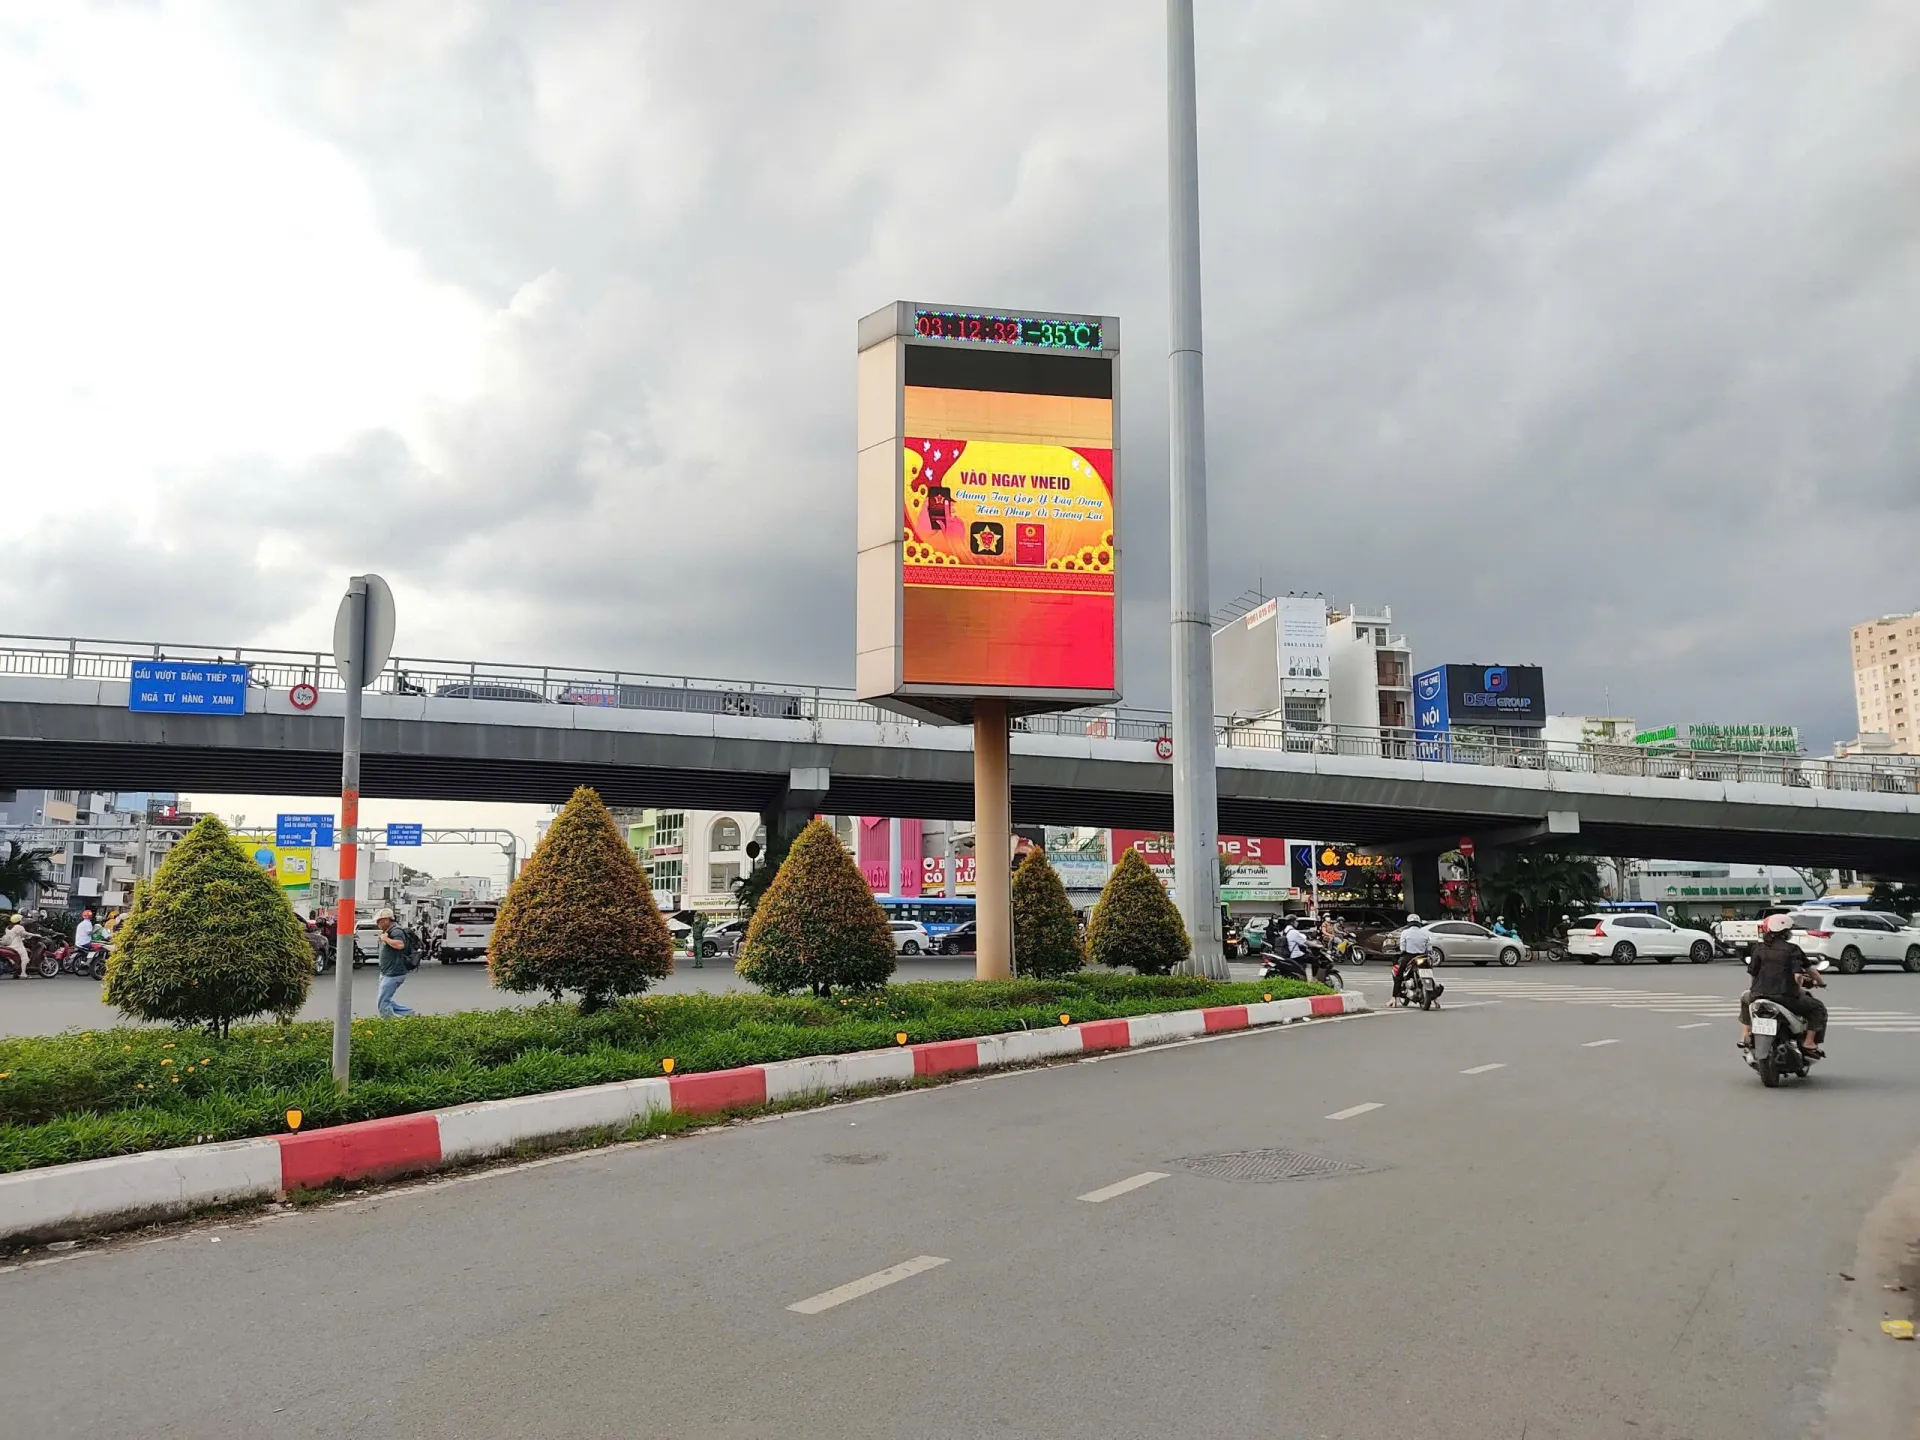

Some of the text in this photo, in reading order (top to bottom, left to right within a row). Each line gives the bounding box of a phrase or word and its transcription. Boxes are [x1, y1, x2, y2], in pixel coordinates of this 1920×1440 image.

[917, 317, 1018, 342] 03:12:32
[960, 469, 1070, 490] VÀO NGAY VNEID
[955, 490, 986, 502] Chung
[991, 491, 1009, 502] Tay
[1086, 511, 1102, 520] Lai
[155, 669, 177, 682] VƯỢT
[206, 670, 228, 683] THÉP
[231, 673, 244, 685] TẠI
[1420, 675, 1439, 688] THE ONE
[141, 691, 234, 705] NGÃ TƯ HÀNG XANH
[1463, 692, 1531, 708] DSG GROUP
[1422, 706, 1440, 728] NỘI
[1689, 723, 1720, 737] PHÒNG
[1321, 841, 1340, 866] Ốc
[1345, 852, 1373, 866] Sữa
